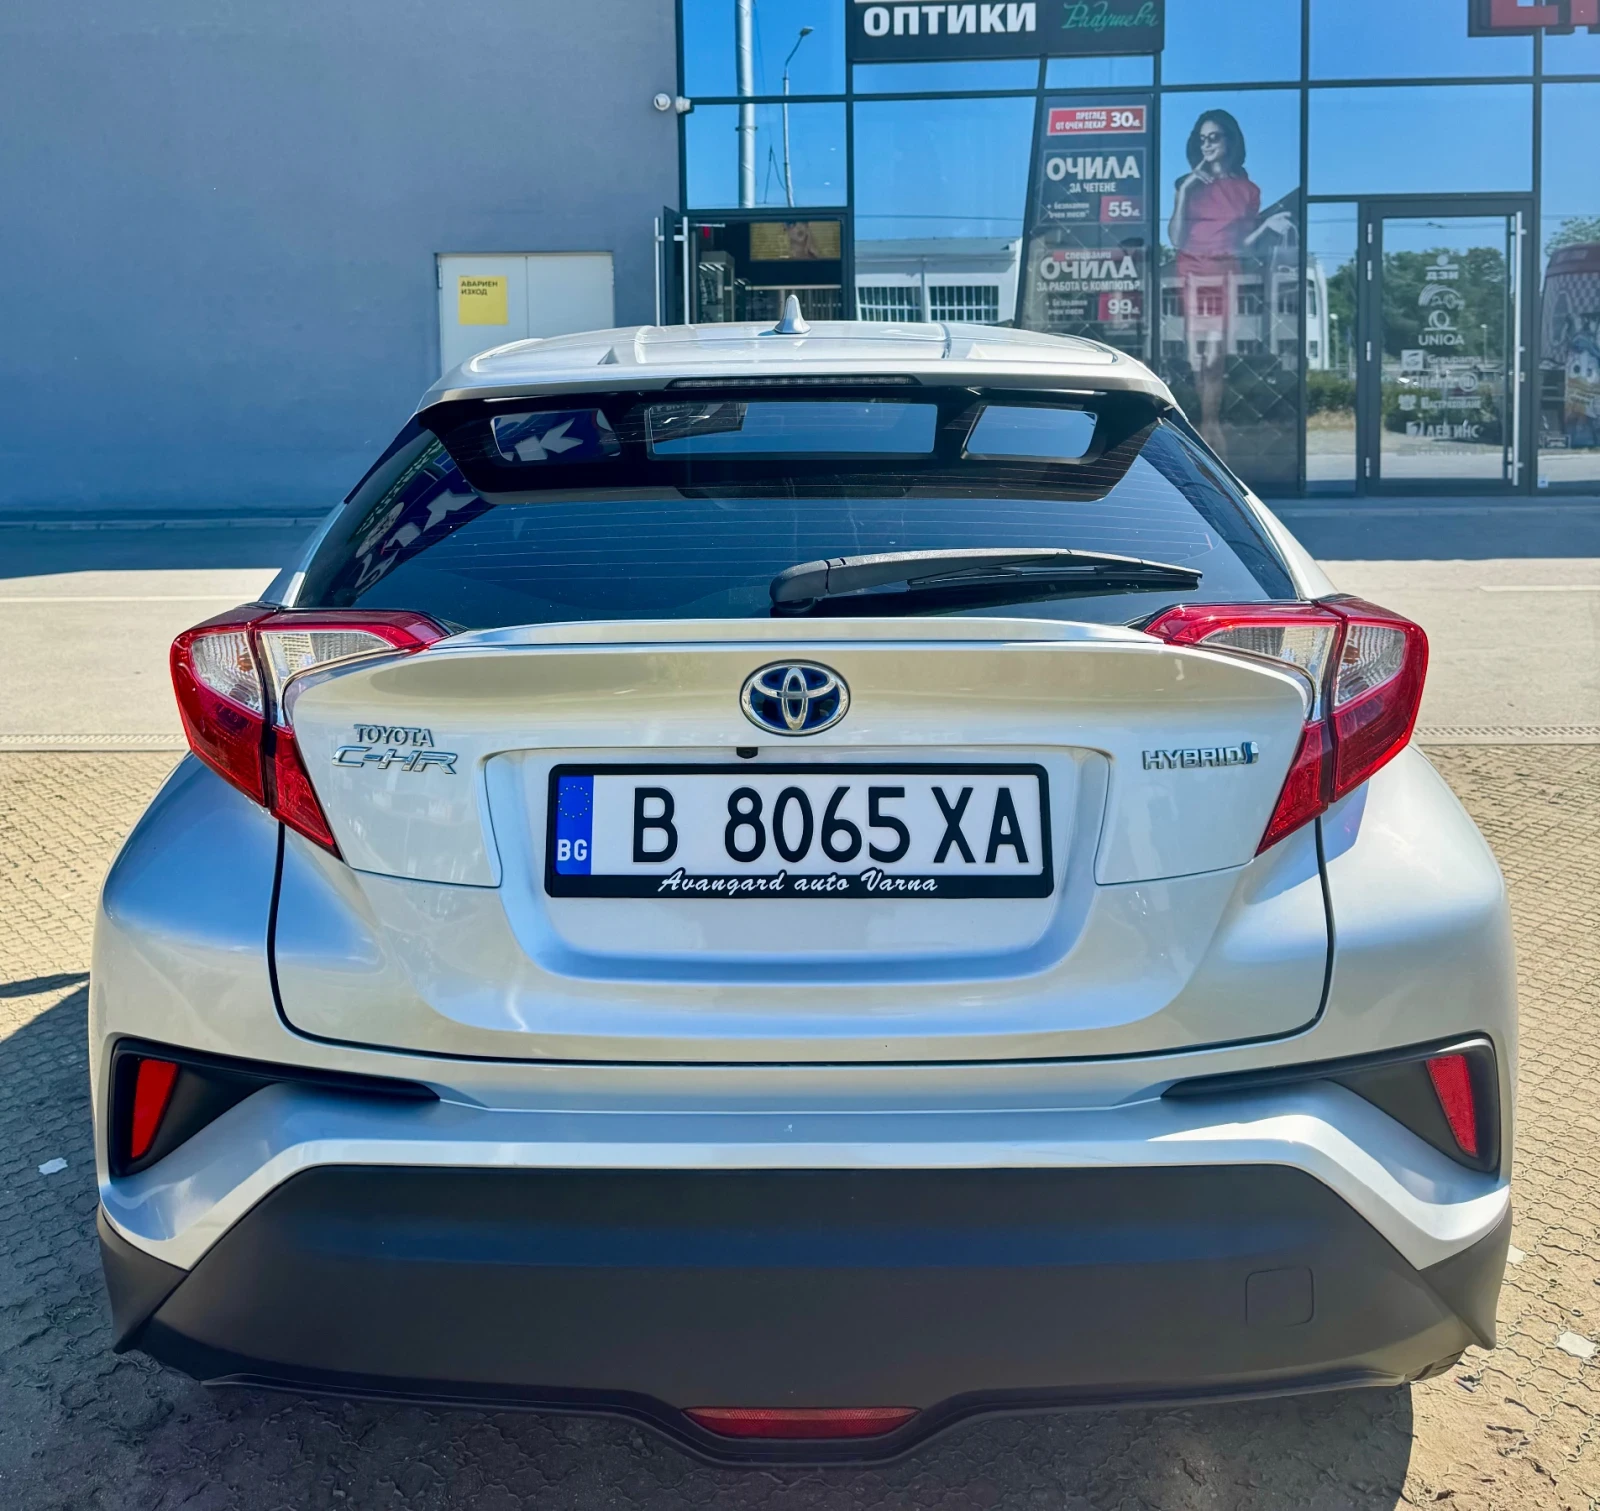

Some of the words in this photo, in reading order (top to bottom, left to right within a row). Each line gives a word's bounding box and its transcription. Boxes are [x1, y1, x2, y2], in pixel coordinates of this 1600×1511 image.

[863, 2, 1037, 37] ОПТИКИ
[1046, 155, 1141, 182] ОЧИЛА
[1069, 182, 1082, 194] ЗА
[1083, 181, 1117, 193] ЧЕТЕНЕ
[1040, 255, 1138, 280] ОЧИЛА
[461, 280, 499, 288] АВАРИЕН
[461, 288, 488, 296] ИЗХОД
[1036, 281, 1048, 292] ЗА
[1049, 281, 1080, 292] РАБОТА
[1082, 281, 1089, 291] С
[1417, 333, 1465, 346] UNIQA
[353, 723, 435, 747] TOYOTA
[332, 745, 458, 774] C-HR
[1142, 746, 1244, 770] HYBRID
[633, 786, 678, 863] B
[724, 785, 911, 863] 8065
[931, 786, 1030, 863] XA
[557, 838, 587, 861] BG
[657, 867, 788, 895] Avangard
[794, 875, 850, 891] auto
[861, 867, 938, 892] Varna
